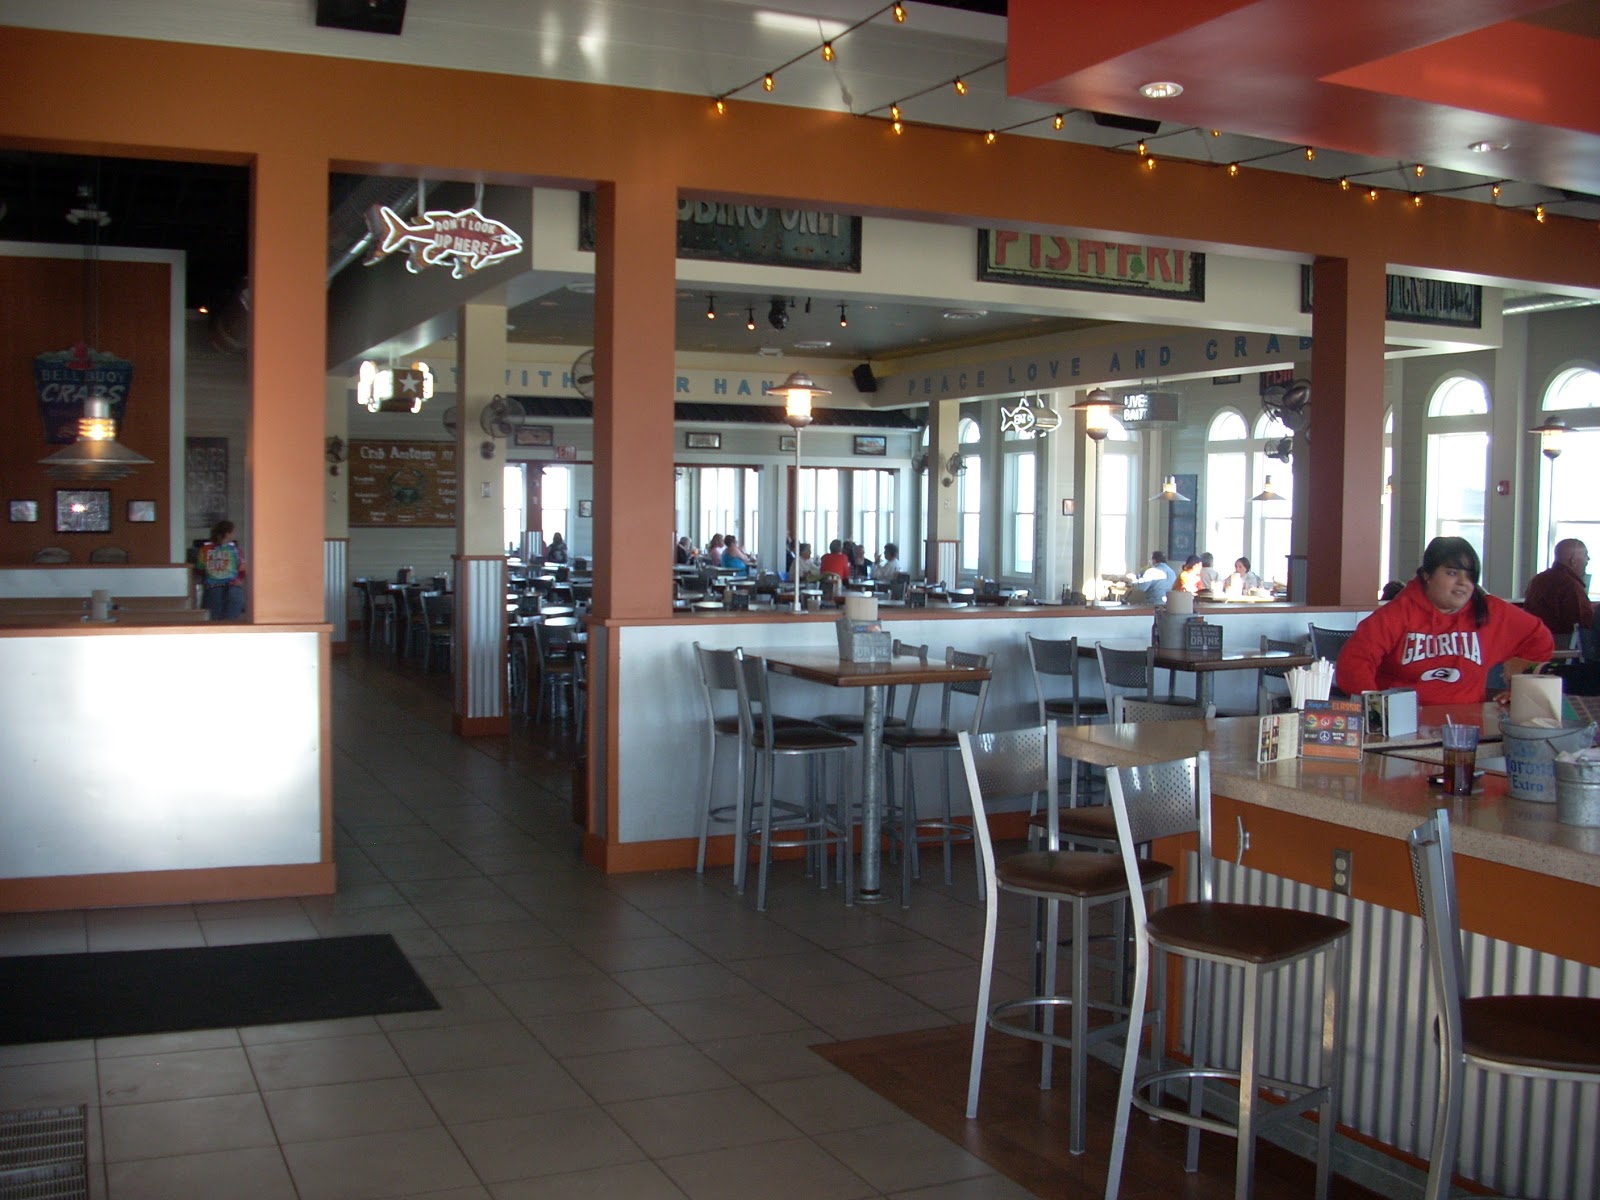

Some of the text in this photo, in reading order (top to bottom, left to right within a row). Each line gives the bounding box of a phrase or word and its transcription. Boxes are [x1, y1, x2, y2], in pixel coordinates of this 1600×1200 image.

[468, 220, 497, 235] LOOK
[434, 234, 498, 255] UP HERE!
[505, 369, 774, 397] ITH HAN
[908, 370, 985, 396] PEACE
[1008, 357, 1081, 384] LOVE
[1109, 346, 1171, 373] AND
[1190, 636, 1220, 645] DRINK
[1402, 631, 1482, 666] GEORGIA
